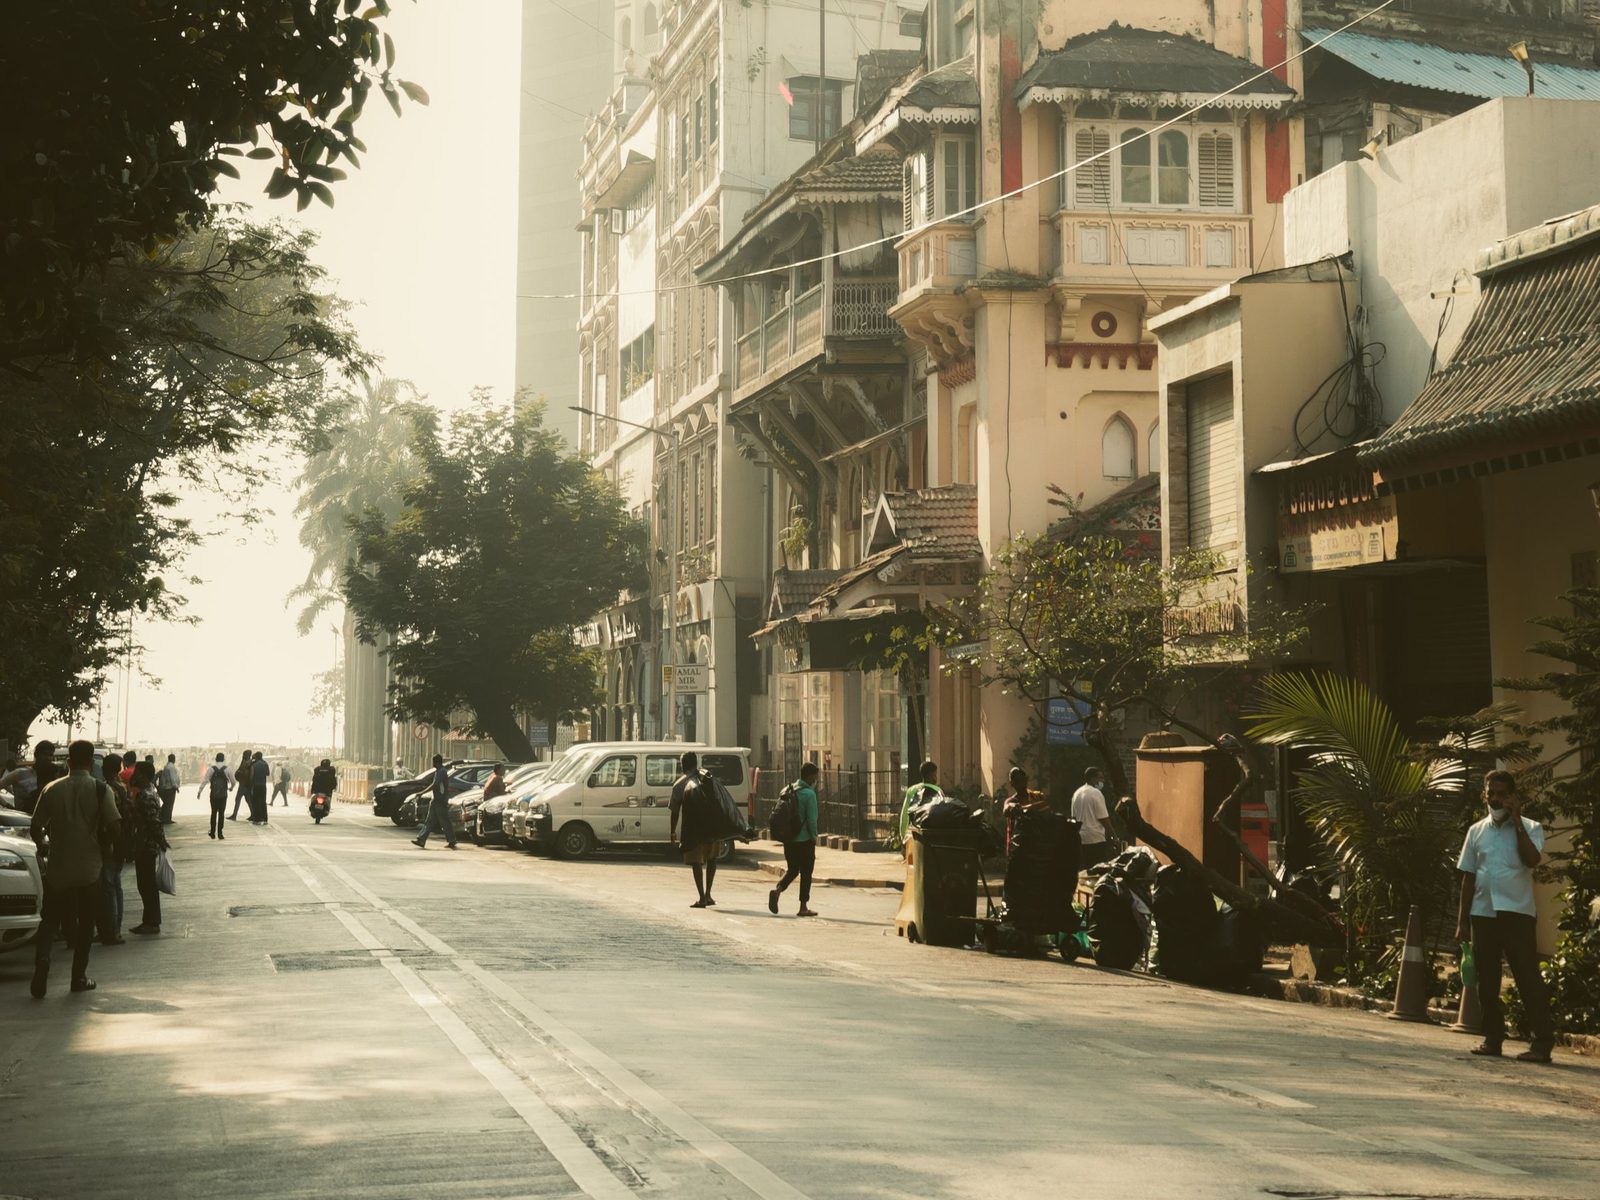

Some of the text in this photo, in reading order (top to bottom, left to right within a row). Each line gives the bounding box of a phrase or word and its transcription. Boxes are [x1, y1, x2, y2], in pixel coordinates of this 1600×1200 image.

[1344, 533, 1364, 549] PCO
[675, 667, 702, 676] AMAL
[679, 676, 696, 685] MIR
